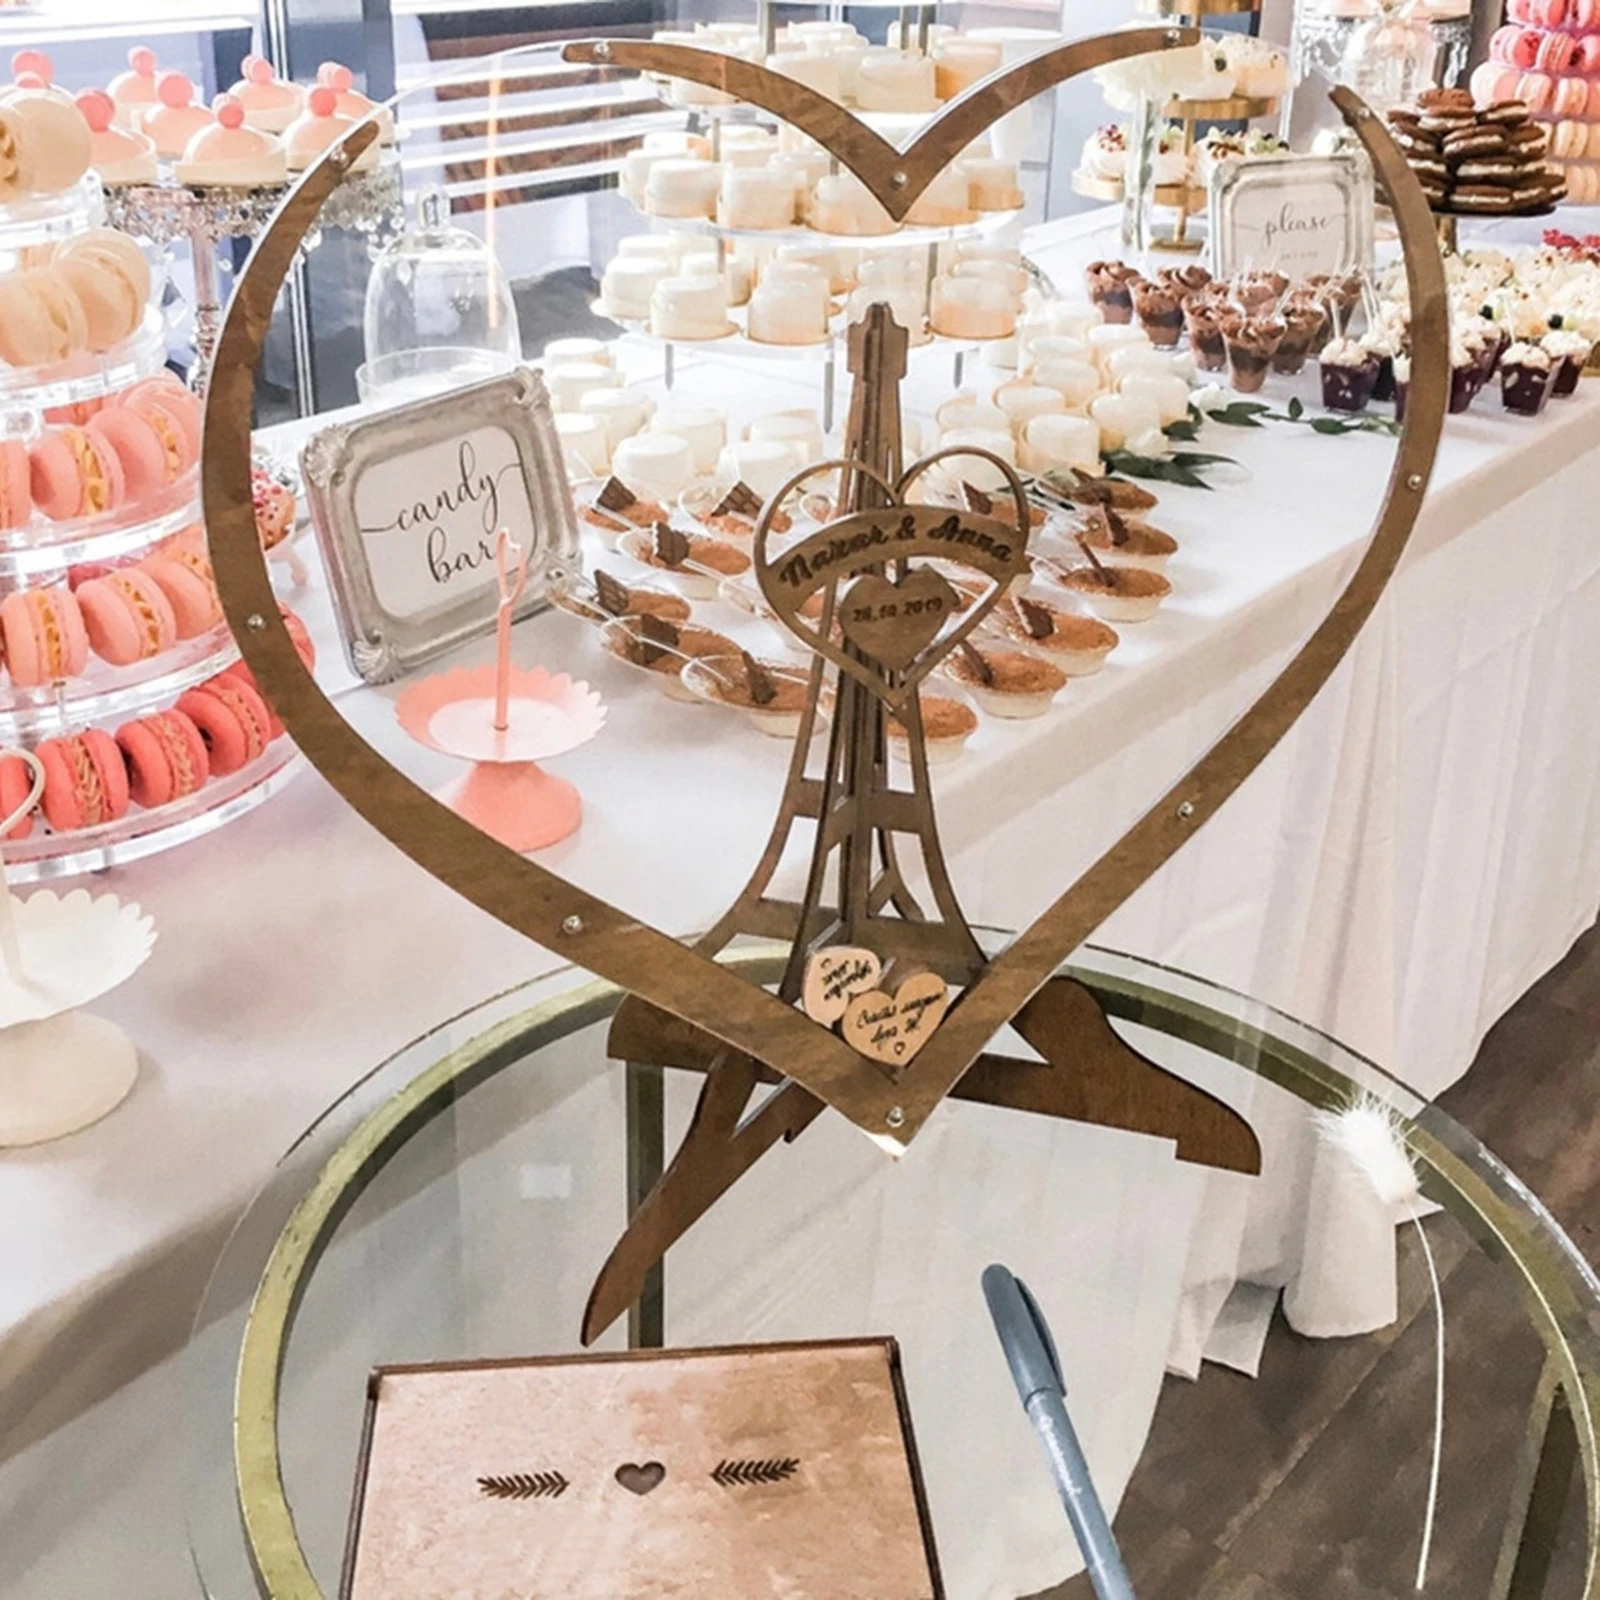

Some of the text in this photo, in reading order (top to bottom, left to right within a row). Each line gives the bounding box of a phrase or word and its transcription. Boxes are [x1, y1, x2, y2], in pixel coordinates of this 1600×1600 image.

[361, 440, 522, 535] candy
[427, 526, 496, 583] bar
[896, 515, 917, 541] &
[927, 515, 1012, 562] Anna
